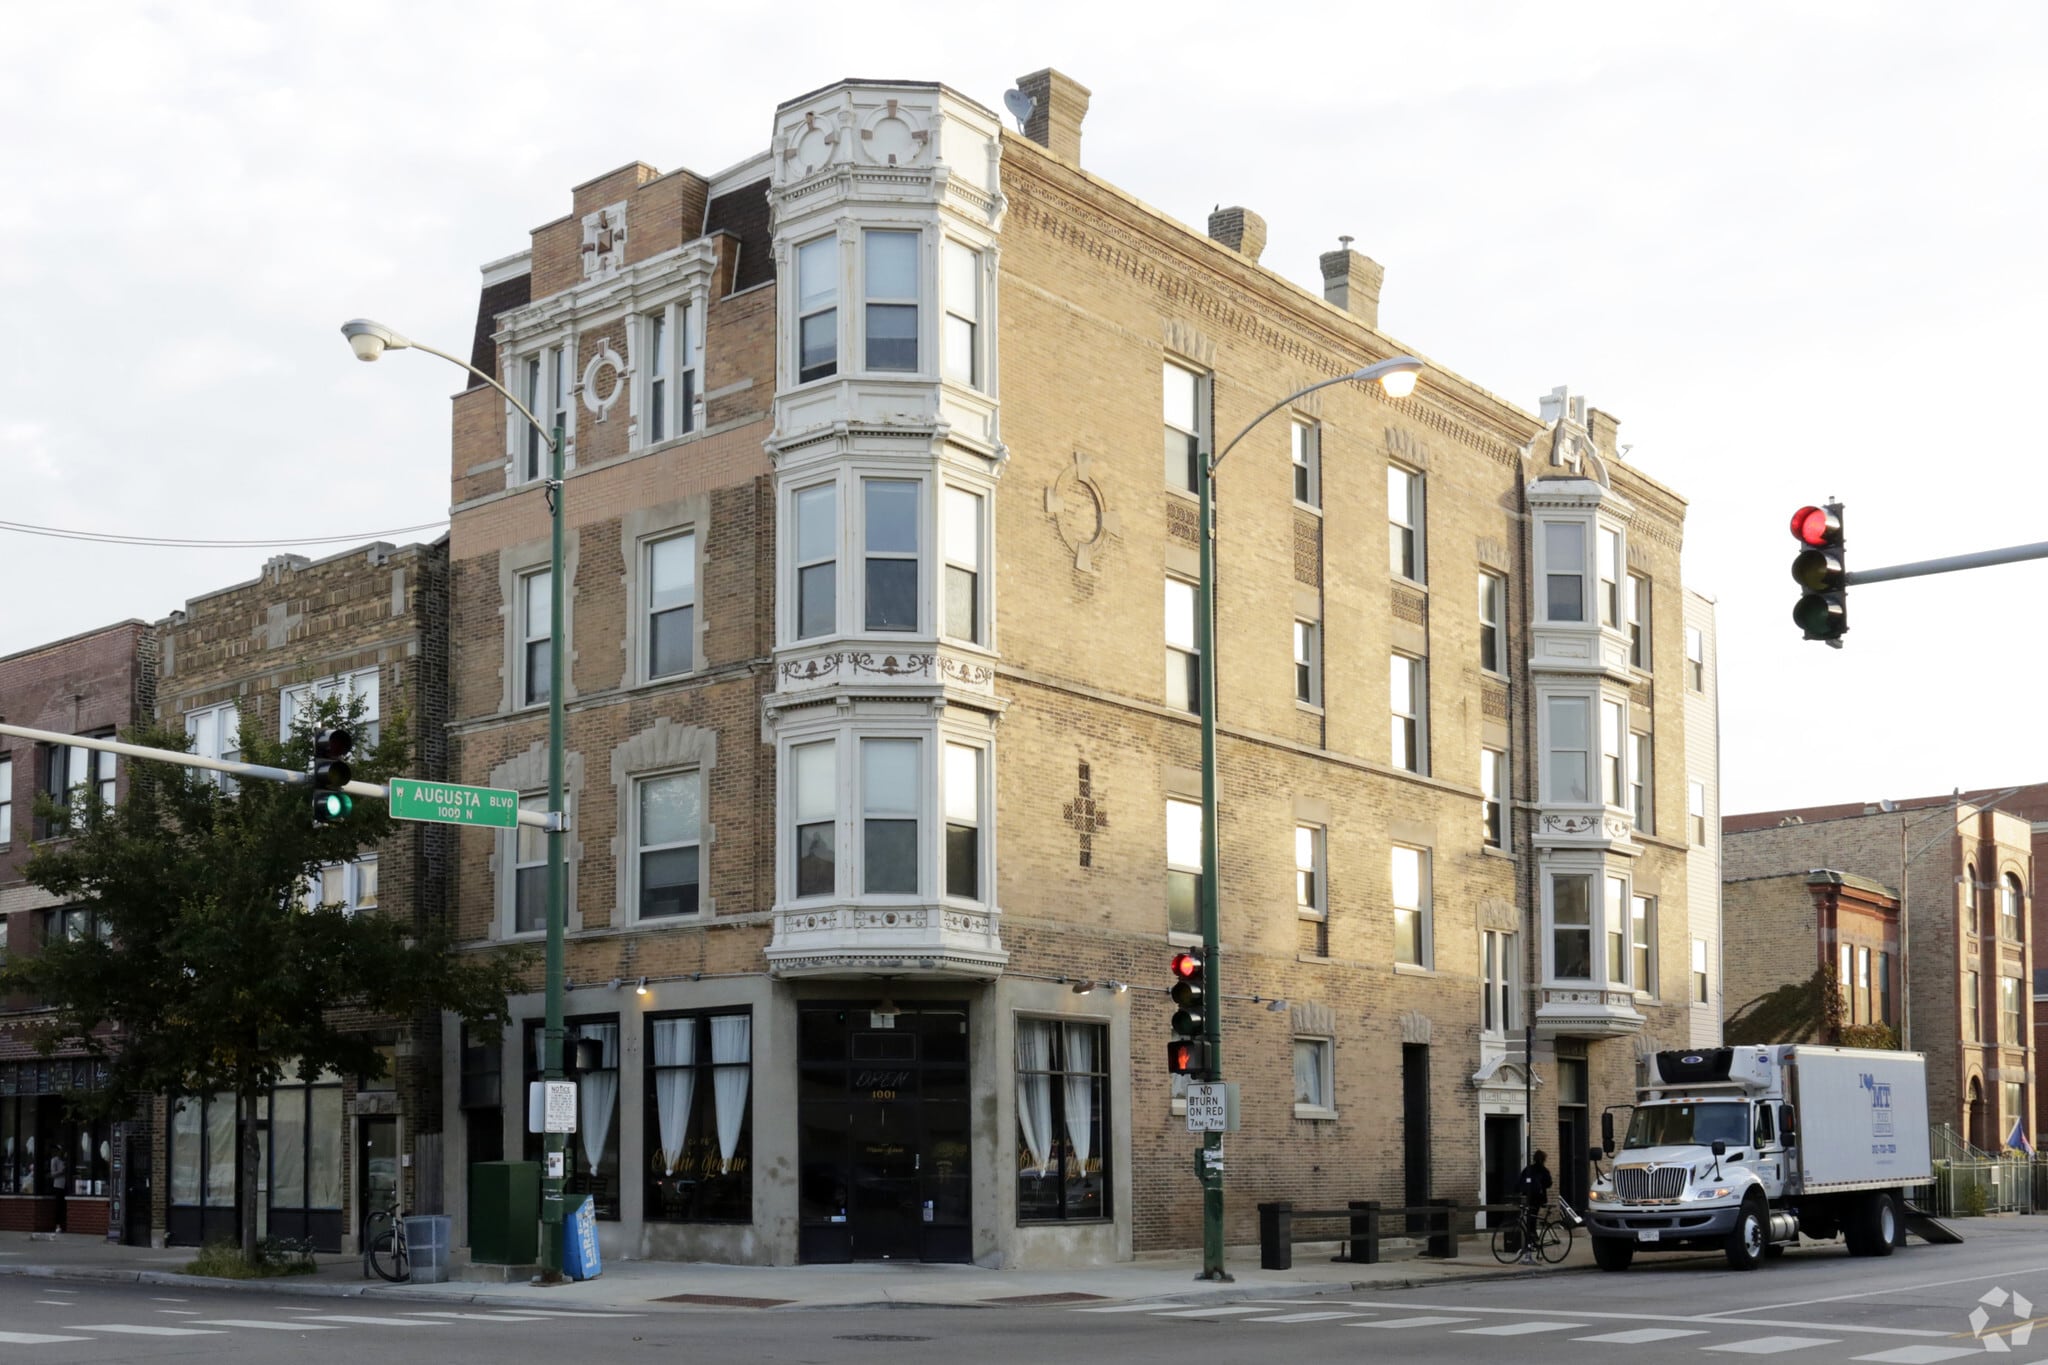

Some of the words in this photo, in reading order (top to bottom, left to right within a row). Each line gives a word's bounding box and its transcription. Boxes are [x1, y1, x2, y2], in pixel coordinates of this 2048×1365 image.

[396, 787, 404, 797] W
[414, 787, 480, 808] AUGUSTA
[490, 796, 513, 808] BLVD
[466, 810, 473, 820] N
[872, 1090, 896, 1099] 1001
[1200, 1087, 1212, 1096] NO
[1195, 1097, 1217, 1105] TURN
[1872, 1086, 1890, 1107] MT
[1190, 1107, 1202, 1116] ON
[1206, 1107, 1223, 1116] RED
